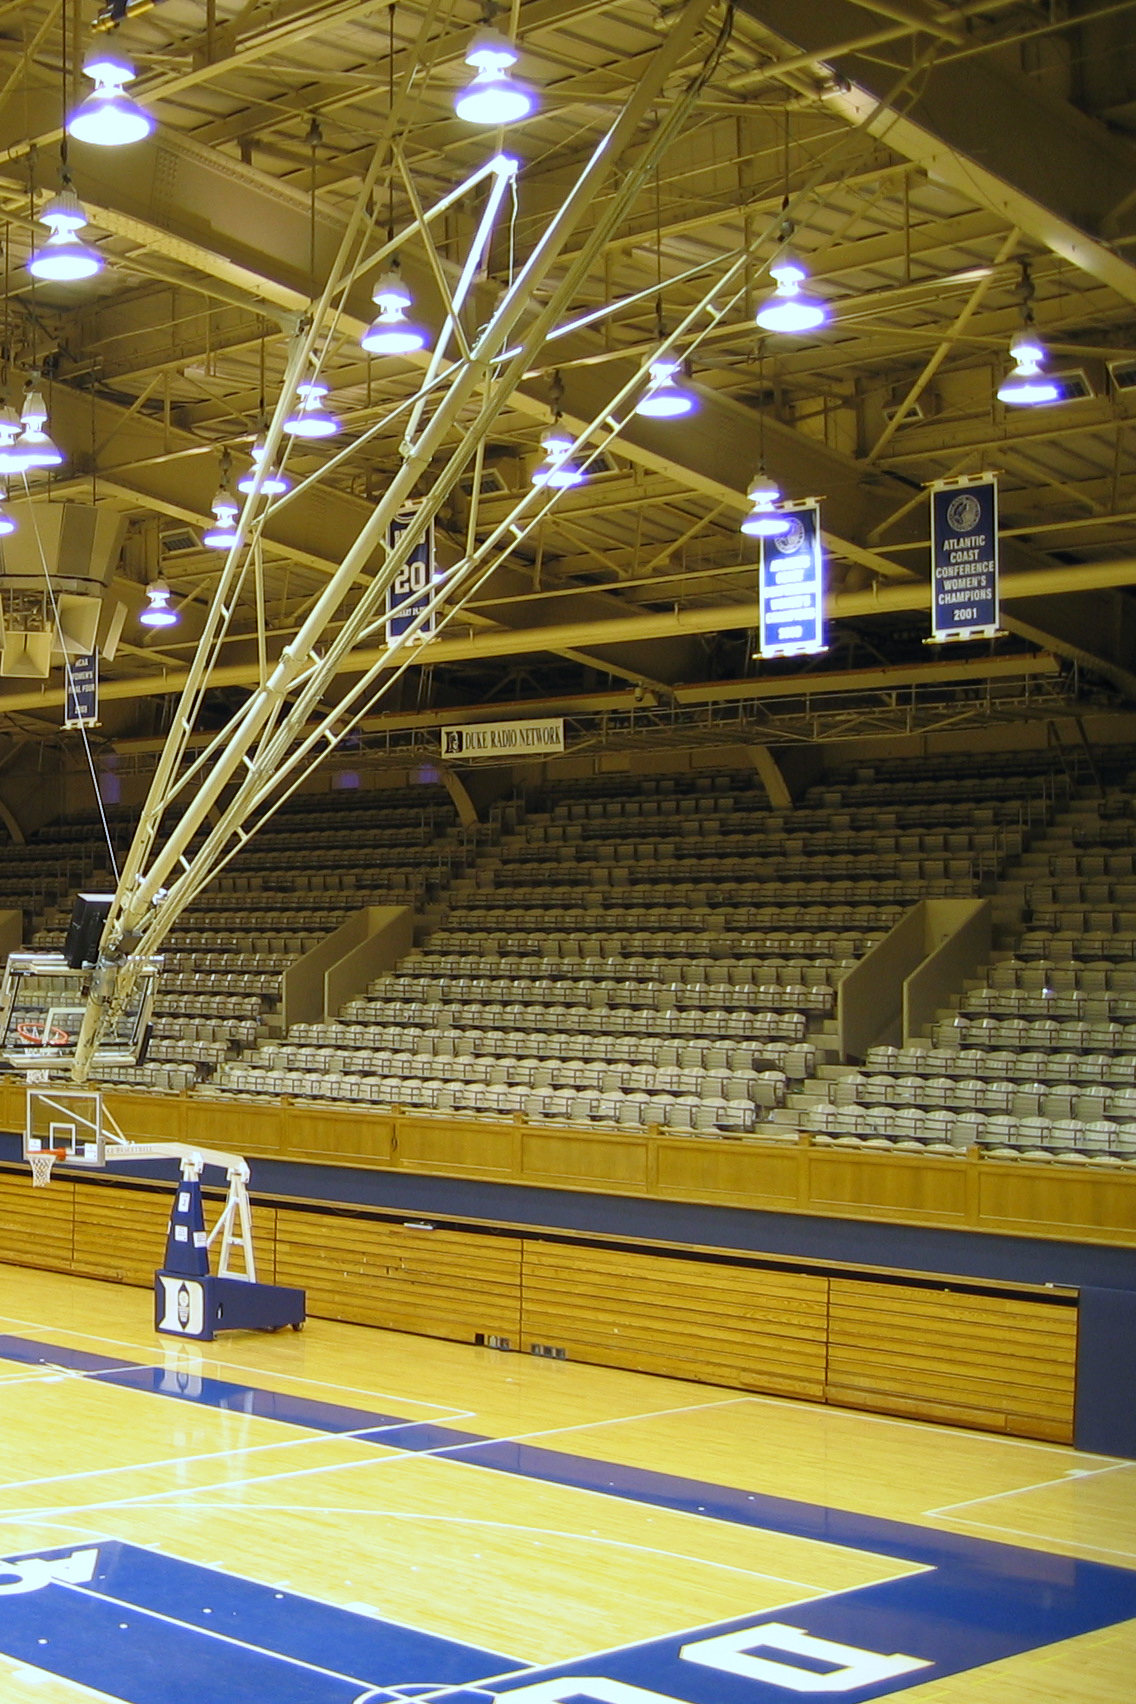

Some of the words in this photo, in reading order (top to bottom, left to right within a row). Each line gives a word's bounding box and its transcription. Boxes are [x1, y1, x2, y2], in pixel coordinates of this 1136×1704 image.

[943, 535, 985, 551] ATLANTIC
[950, 550, 979, 563] COAST
[395, 561, 425, 594] 20
[936, 561, 994, 578] CONFERENCE
[943, 576, 986, 591] WOMEN'S
[938, 588, 992, 605] CHAMPIONS
[953, 607, 977, 621] 2001
[465, 731, 488, 750] DUKE
[490, 729, 517, 748] RADIO
[519, 726, 561, 747] NETWORK
